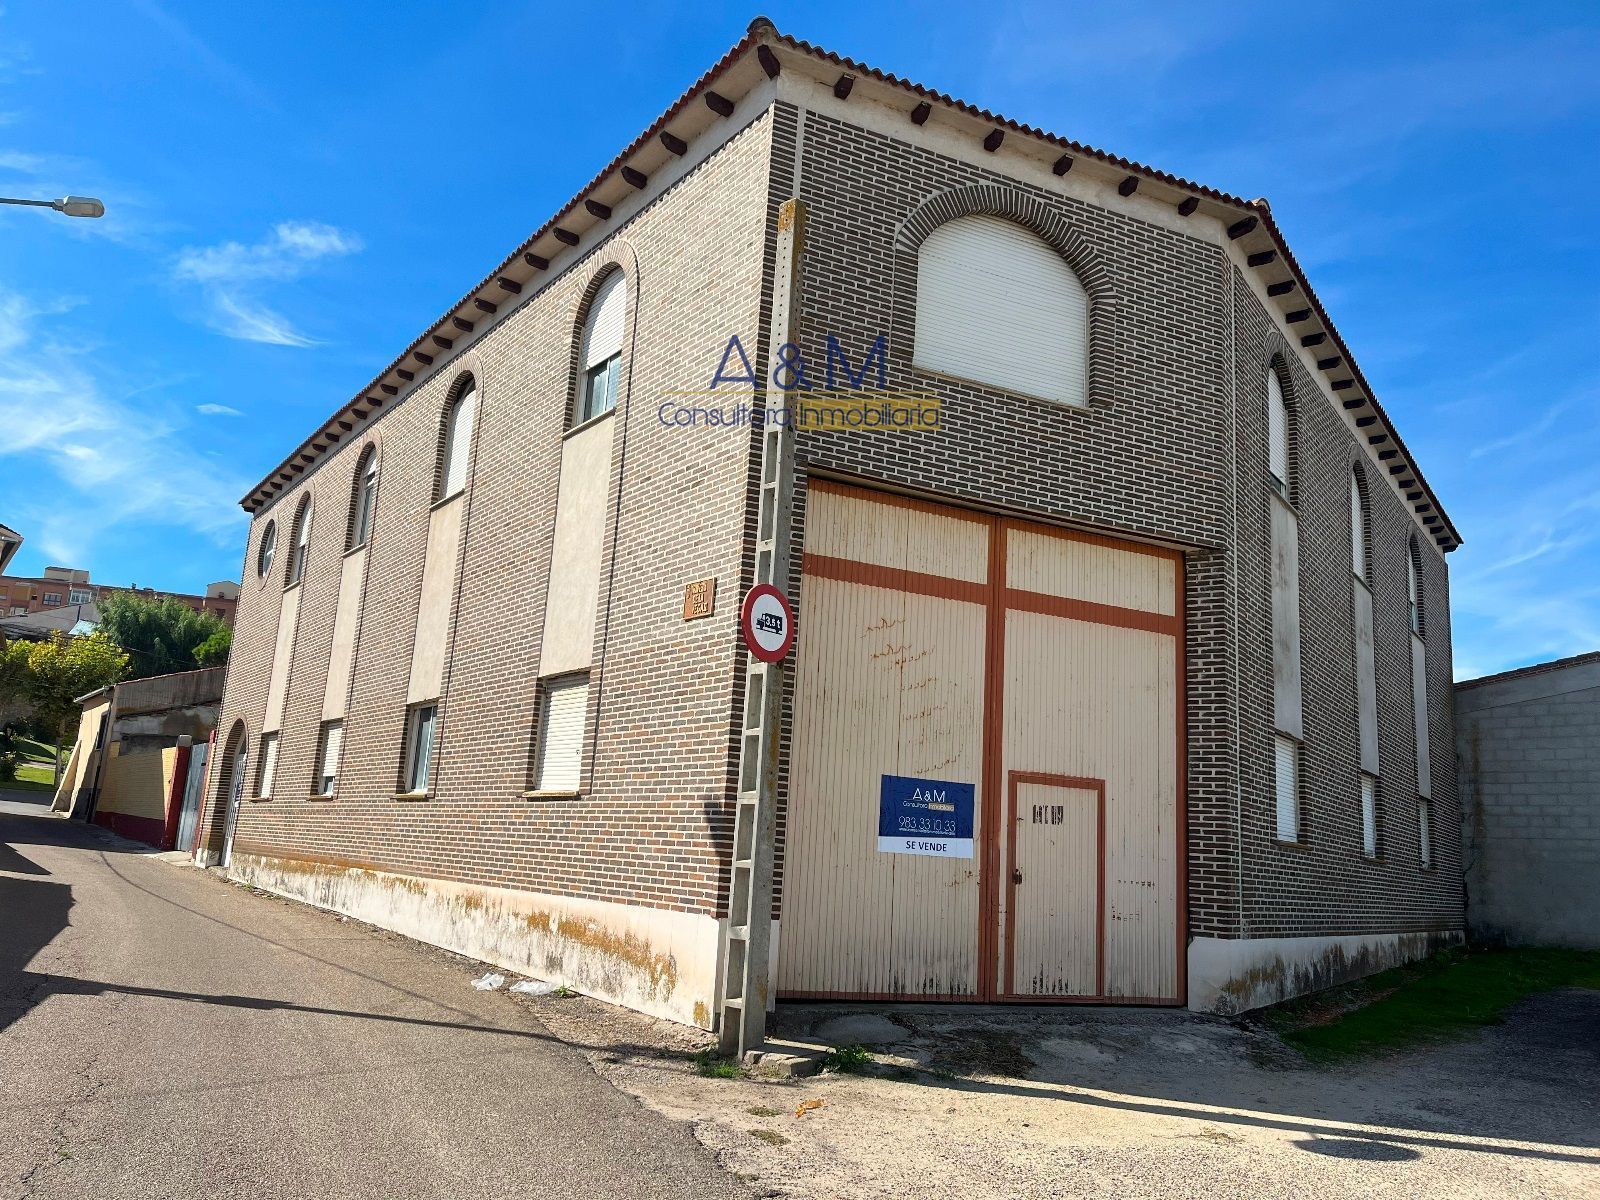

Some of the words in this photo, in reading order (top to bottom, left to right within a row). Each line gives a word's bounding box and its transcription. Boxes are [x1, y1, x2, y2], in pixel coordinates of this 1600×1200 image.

[912, 788, 946, 802] A&M
[899, 816, 916, 828] 983
[919, 817, 930, 830] 33
[933, 818, 941, 831] 10
[944, 820, 955, 831] 33
[906, 841, 916, 850] SE
[918, 841, 947, 852] VENDE
